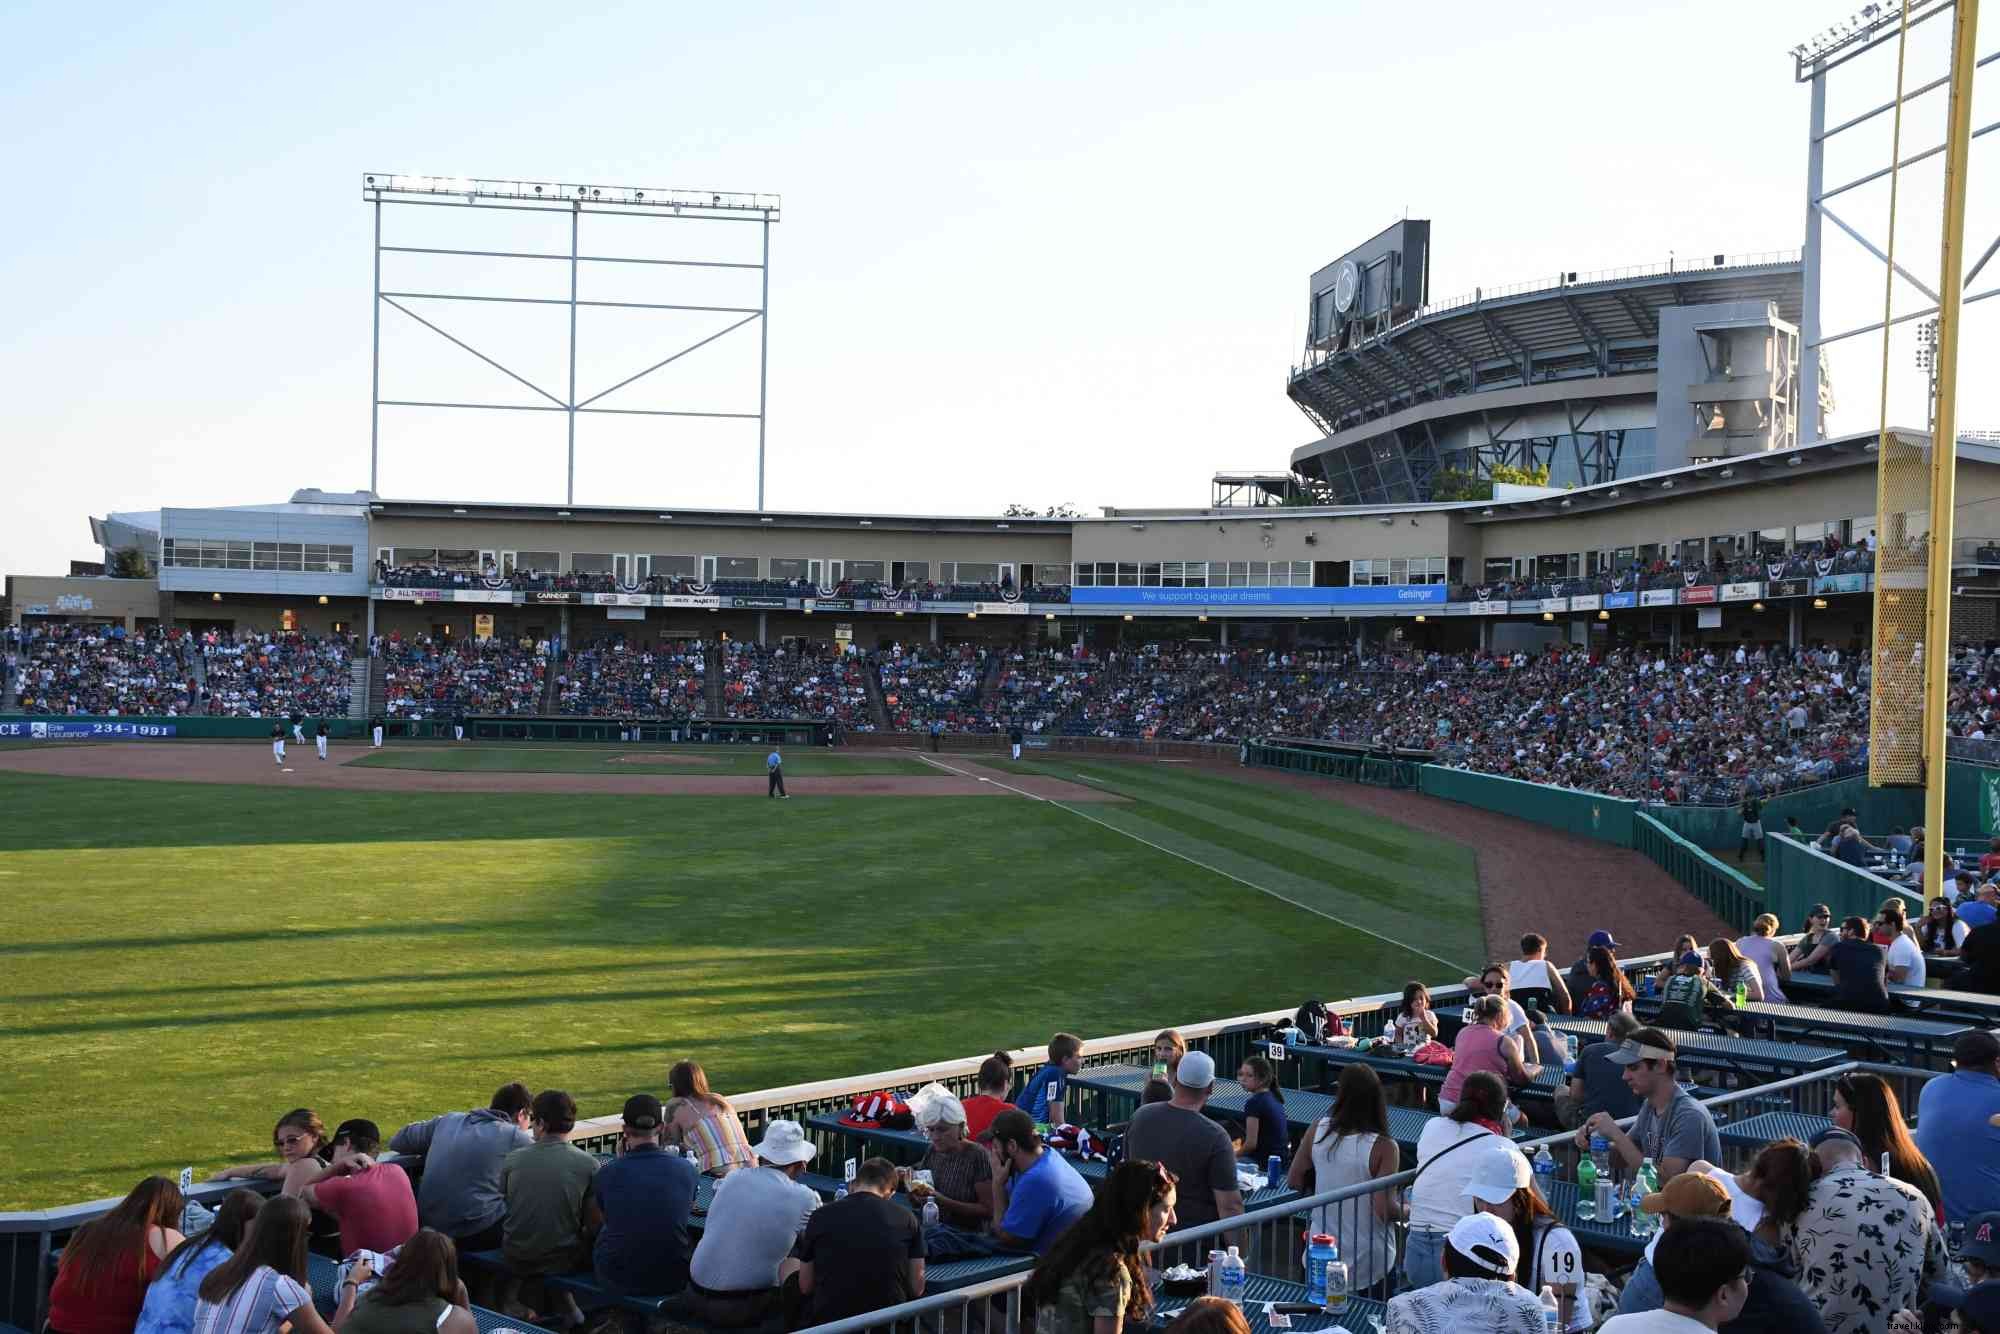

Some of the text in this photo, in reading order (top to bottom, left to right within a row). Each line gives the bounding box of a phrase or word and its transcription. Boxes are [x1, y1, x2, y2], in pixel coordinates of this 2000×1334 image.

[1142, 591, 1155, 600] We
[1159, 592, 1192, 602] support
[1210, 592, 1238, 602] league
[1239, 591, 1270, 601] dreams
[1398, 589, 1432, 600] Geisinger
[94, 723, 168, 736] 234-1991
[1271, 1045, 1282, 1057] 39
[846, 1160, 855, 1178] 37
[1975, 1222, 1992, 1241] A
[1552, 1251, 1575, 1273] 19
